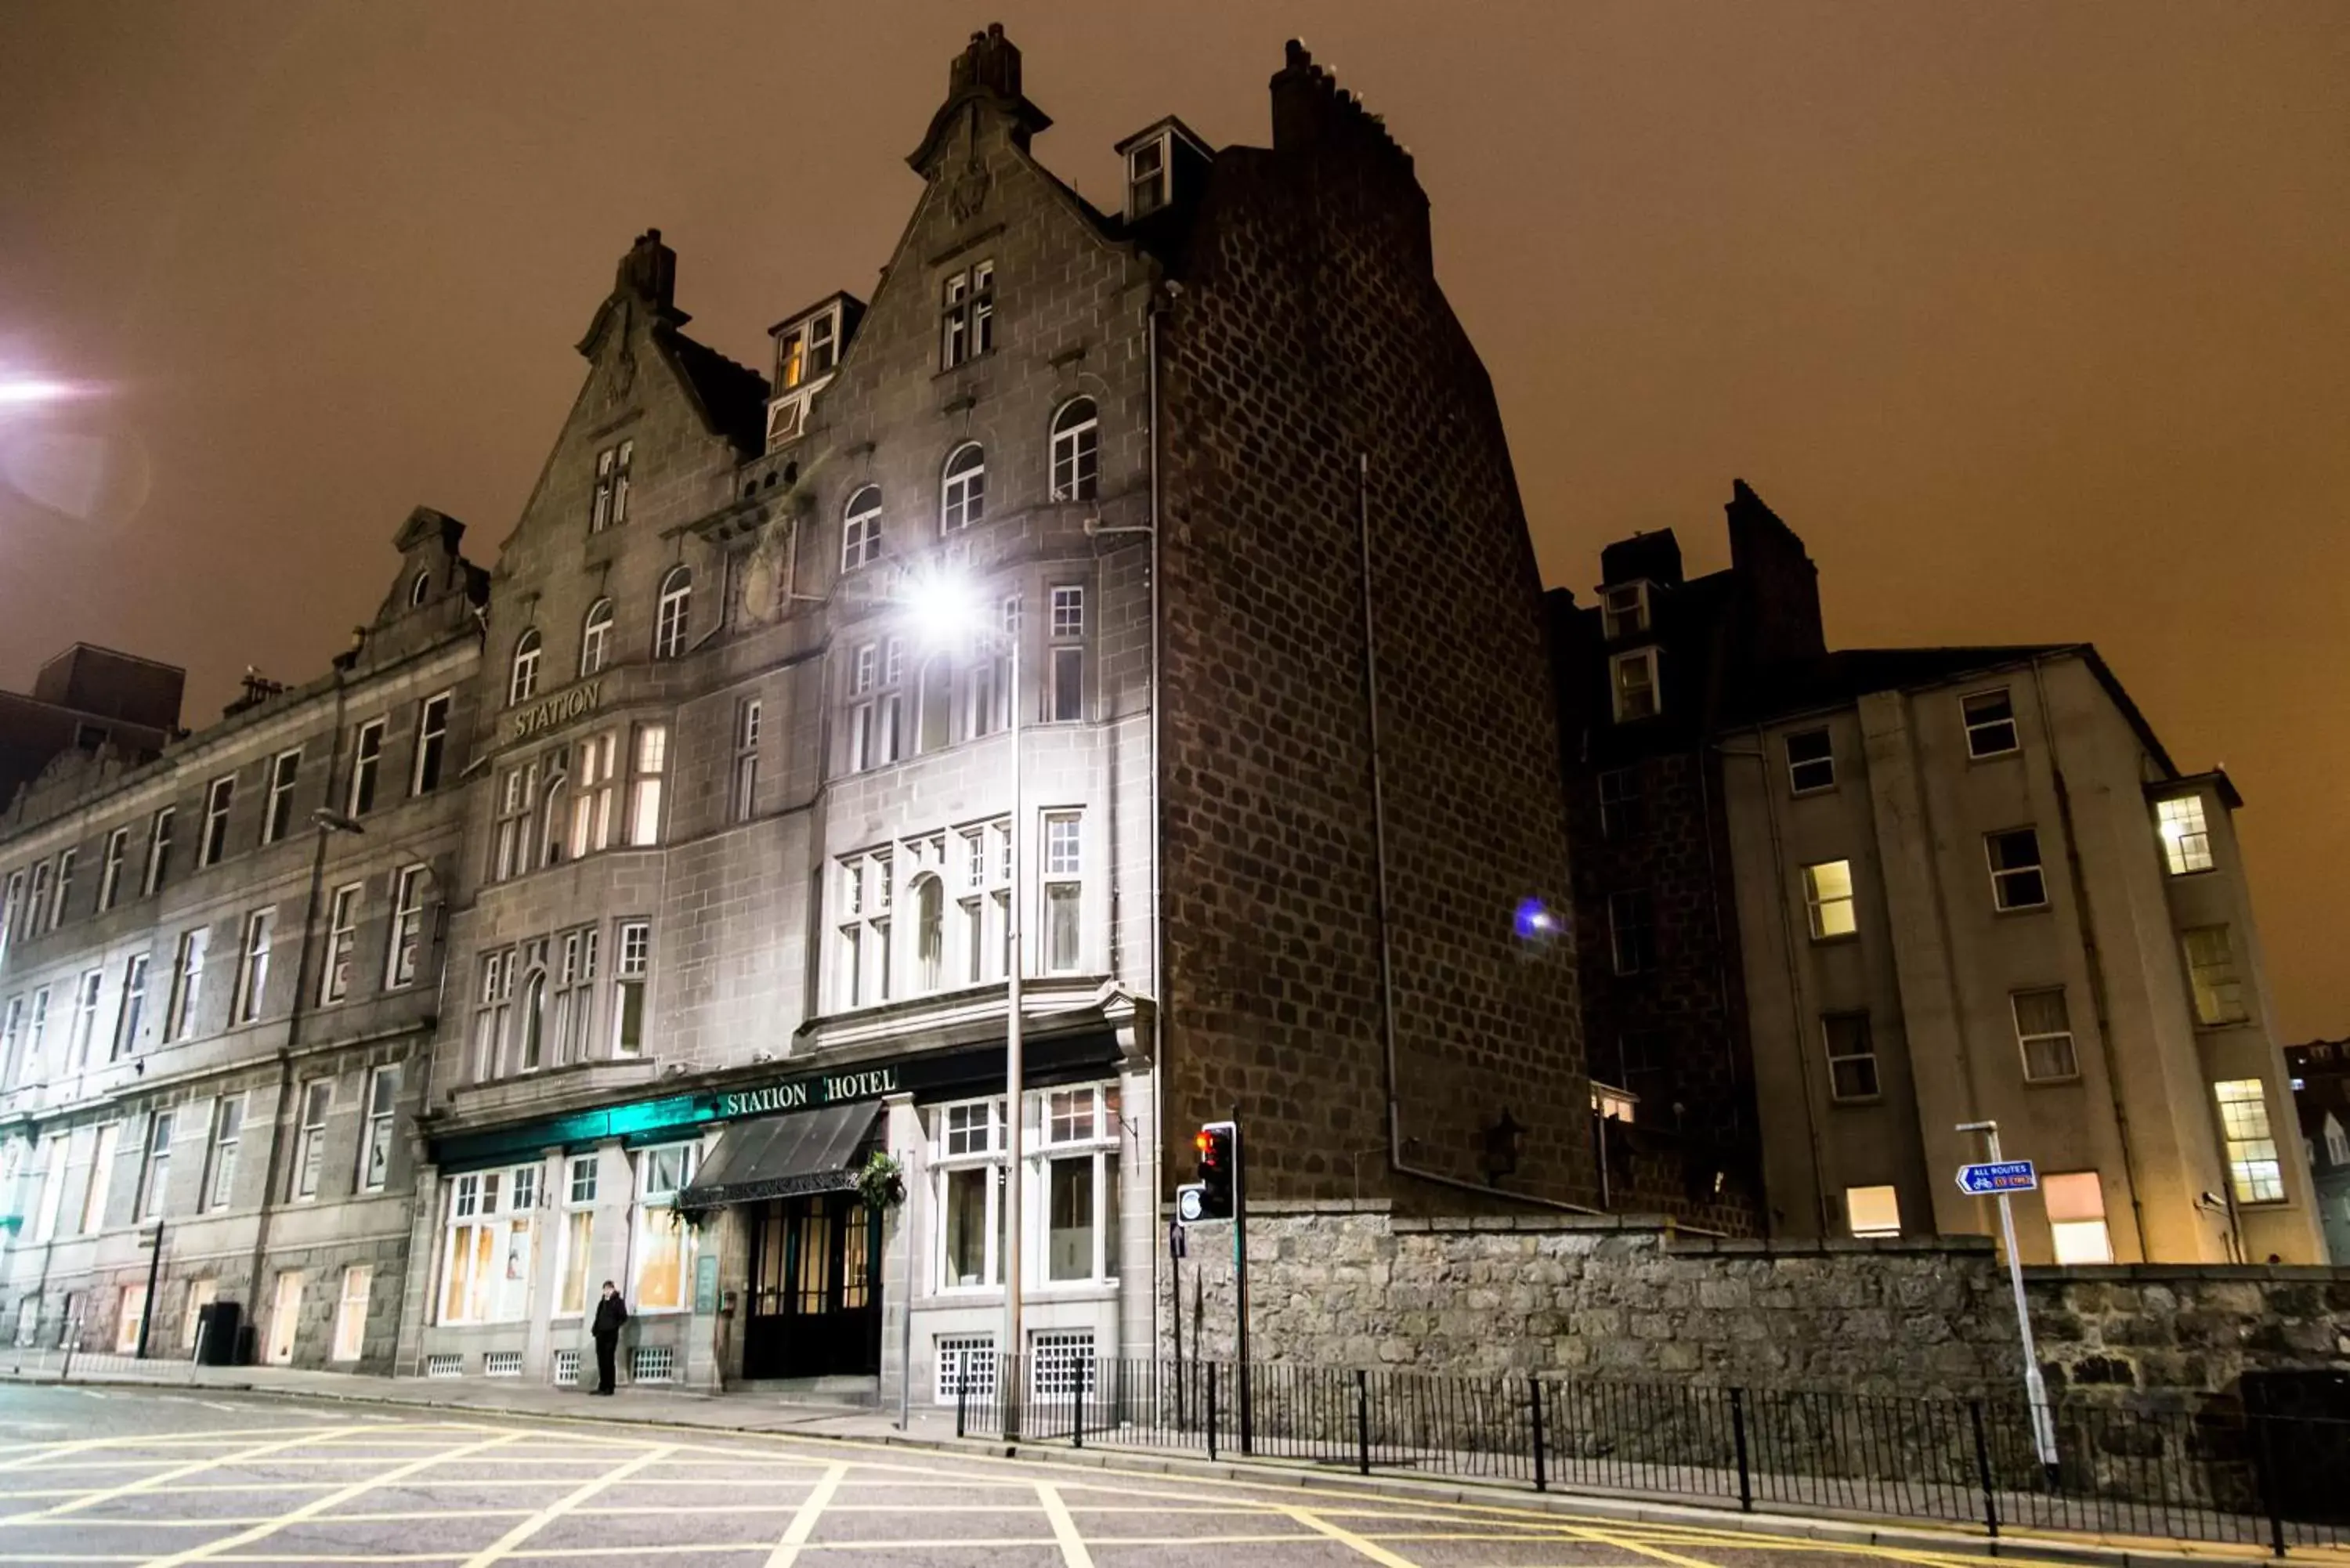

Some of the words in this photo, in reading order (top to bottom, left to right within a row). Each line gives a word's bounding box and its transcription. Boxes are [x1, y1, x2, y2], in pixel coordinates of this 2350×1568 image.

[514, 684, 600, 737] STATION
[727, 1083, 807, 1115] STATION
[826, 1069, 895, 1100] HOTEL
[1991, 1164, 2026, 1174] ROUTES
